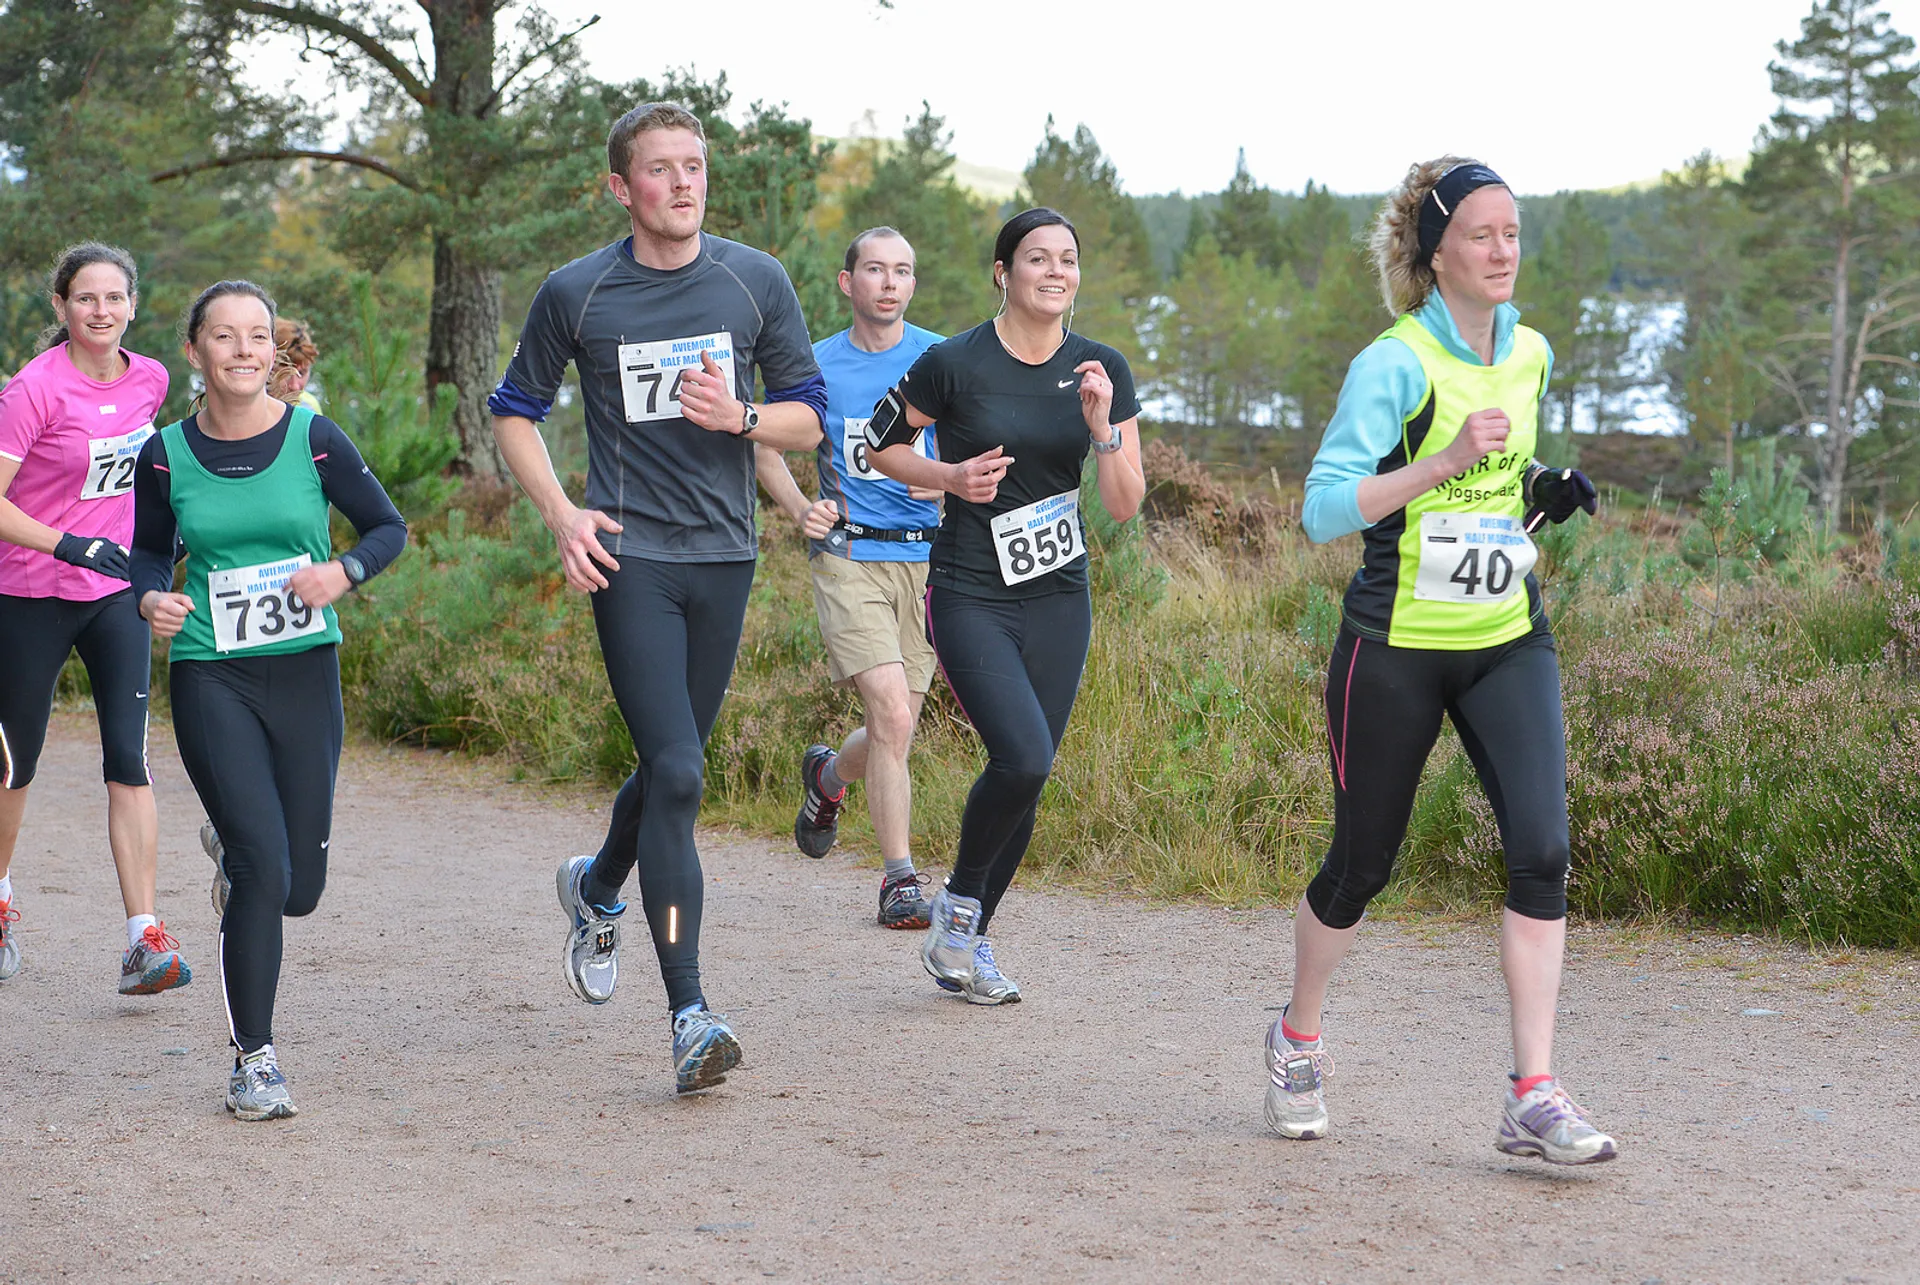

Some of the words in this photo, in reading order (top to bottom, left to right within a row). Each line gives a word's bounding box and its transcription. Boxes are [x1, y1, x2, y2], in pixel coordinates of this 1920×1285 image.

[660, 356, 681, 368] HALF
[682, 349, 731, 365] MARTHON
[671, 338, 716, 354] AVIEMORE
[637, 365, 723, 414] 74
[99, 456, 136, 492] 72
[1498, 453, 1518, 471] of
[1027, 516, 1044, 530] HALF
[1045, 501, 1076, 523] MARATHON
[1008, 519, 1074, 576] 859
[258, 561, 301, 578] AVIEMORE
[1449, 548, 1513, 595] 40
[246, 580, 268, 594] HALF
[225, 589, 312, 642] 739
